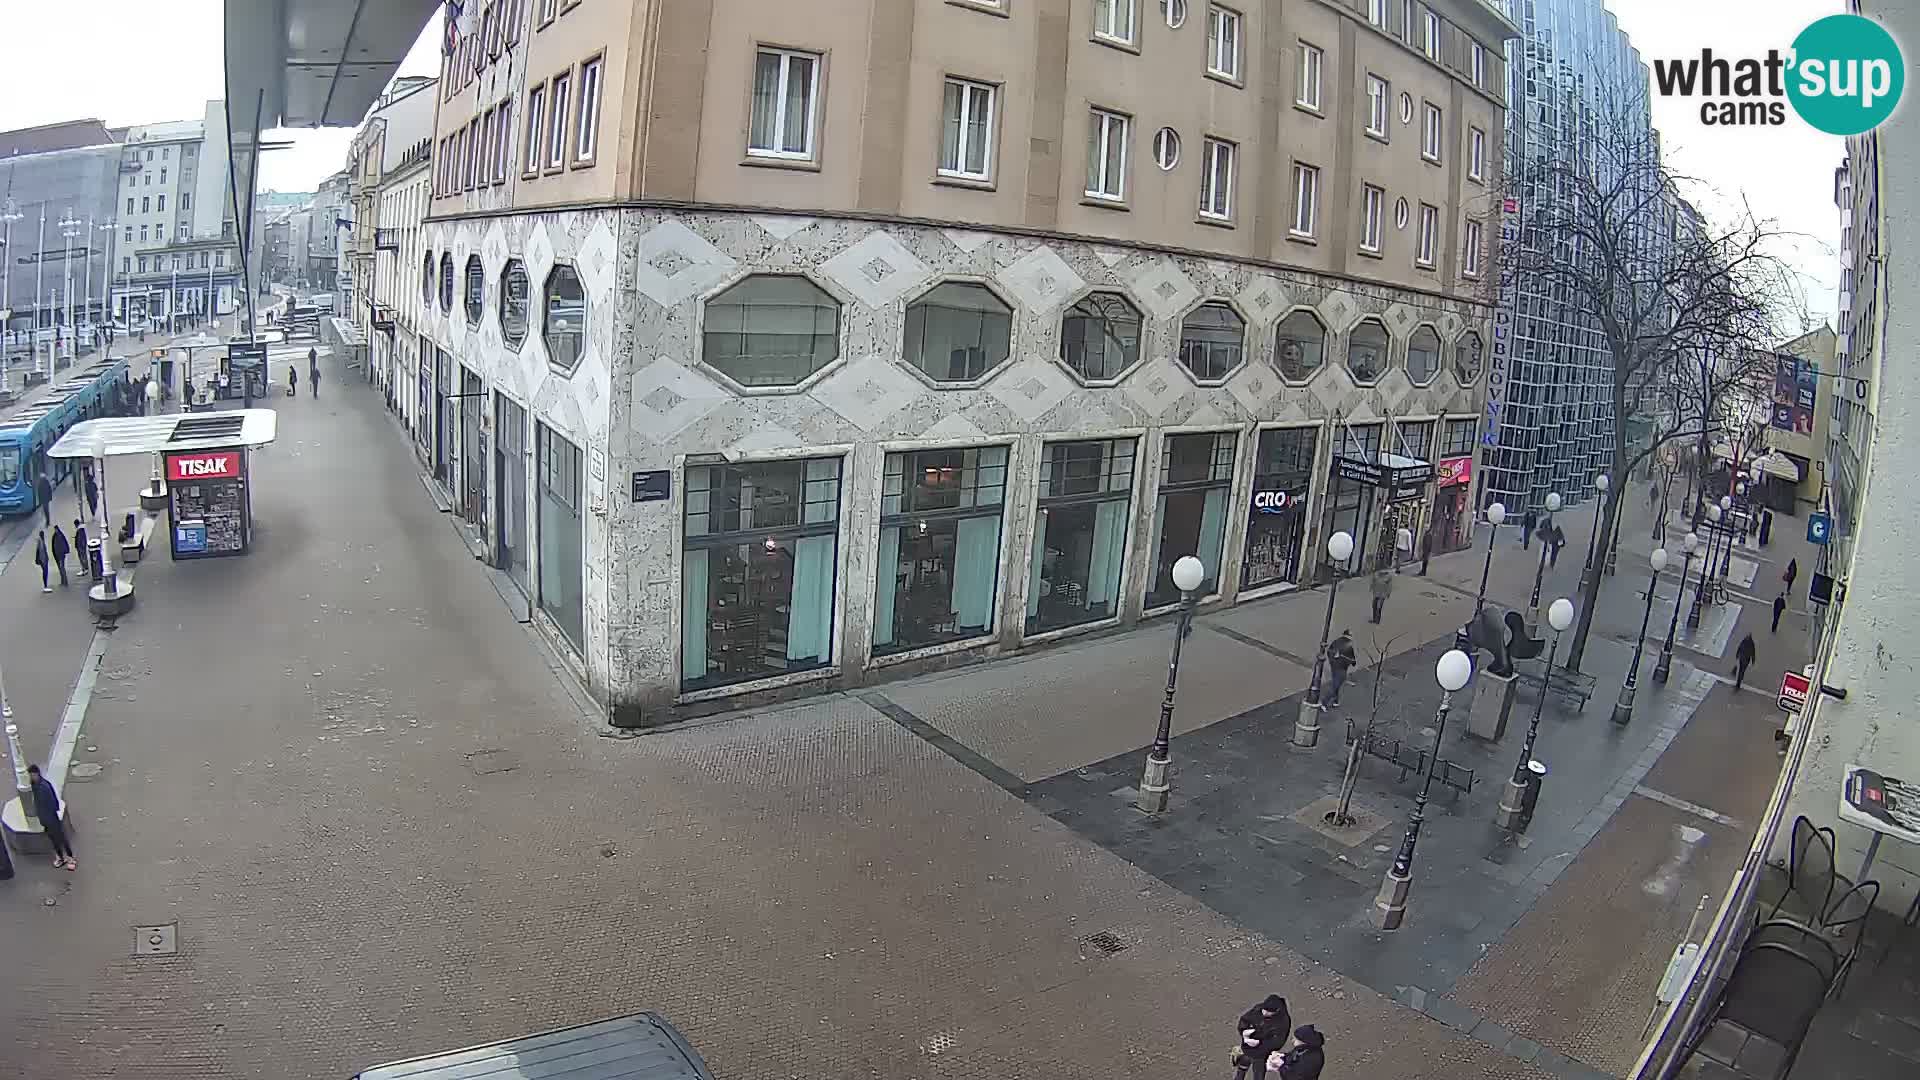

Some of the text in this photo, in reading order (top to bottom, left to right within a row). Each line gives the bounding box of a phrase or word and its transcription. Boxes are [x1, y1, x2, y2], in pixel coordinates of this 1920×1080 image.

[1482, 311, 1509, 446] DUBROVNIK
[178, 457, 228, 476] TISAK
[1255, 491, 1286, 507] CRO
